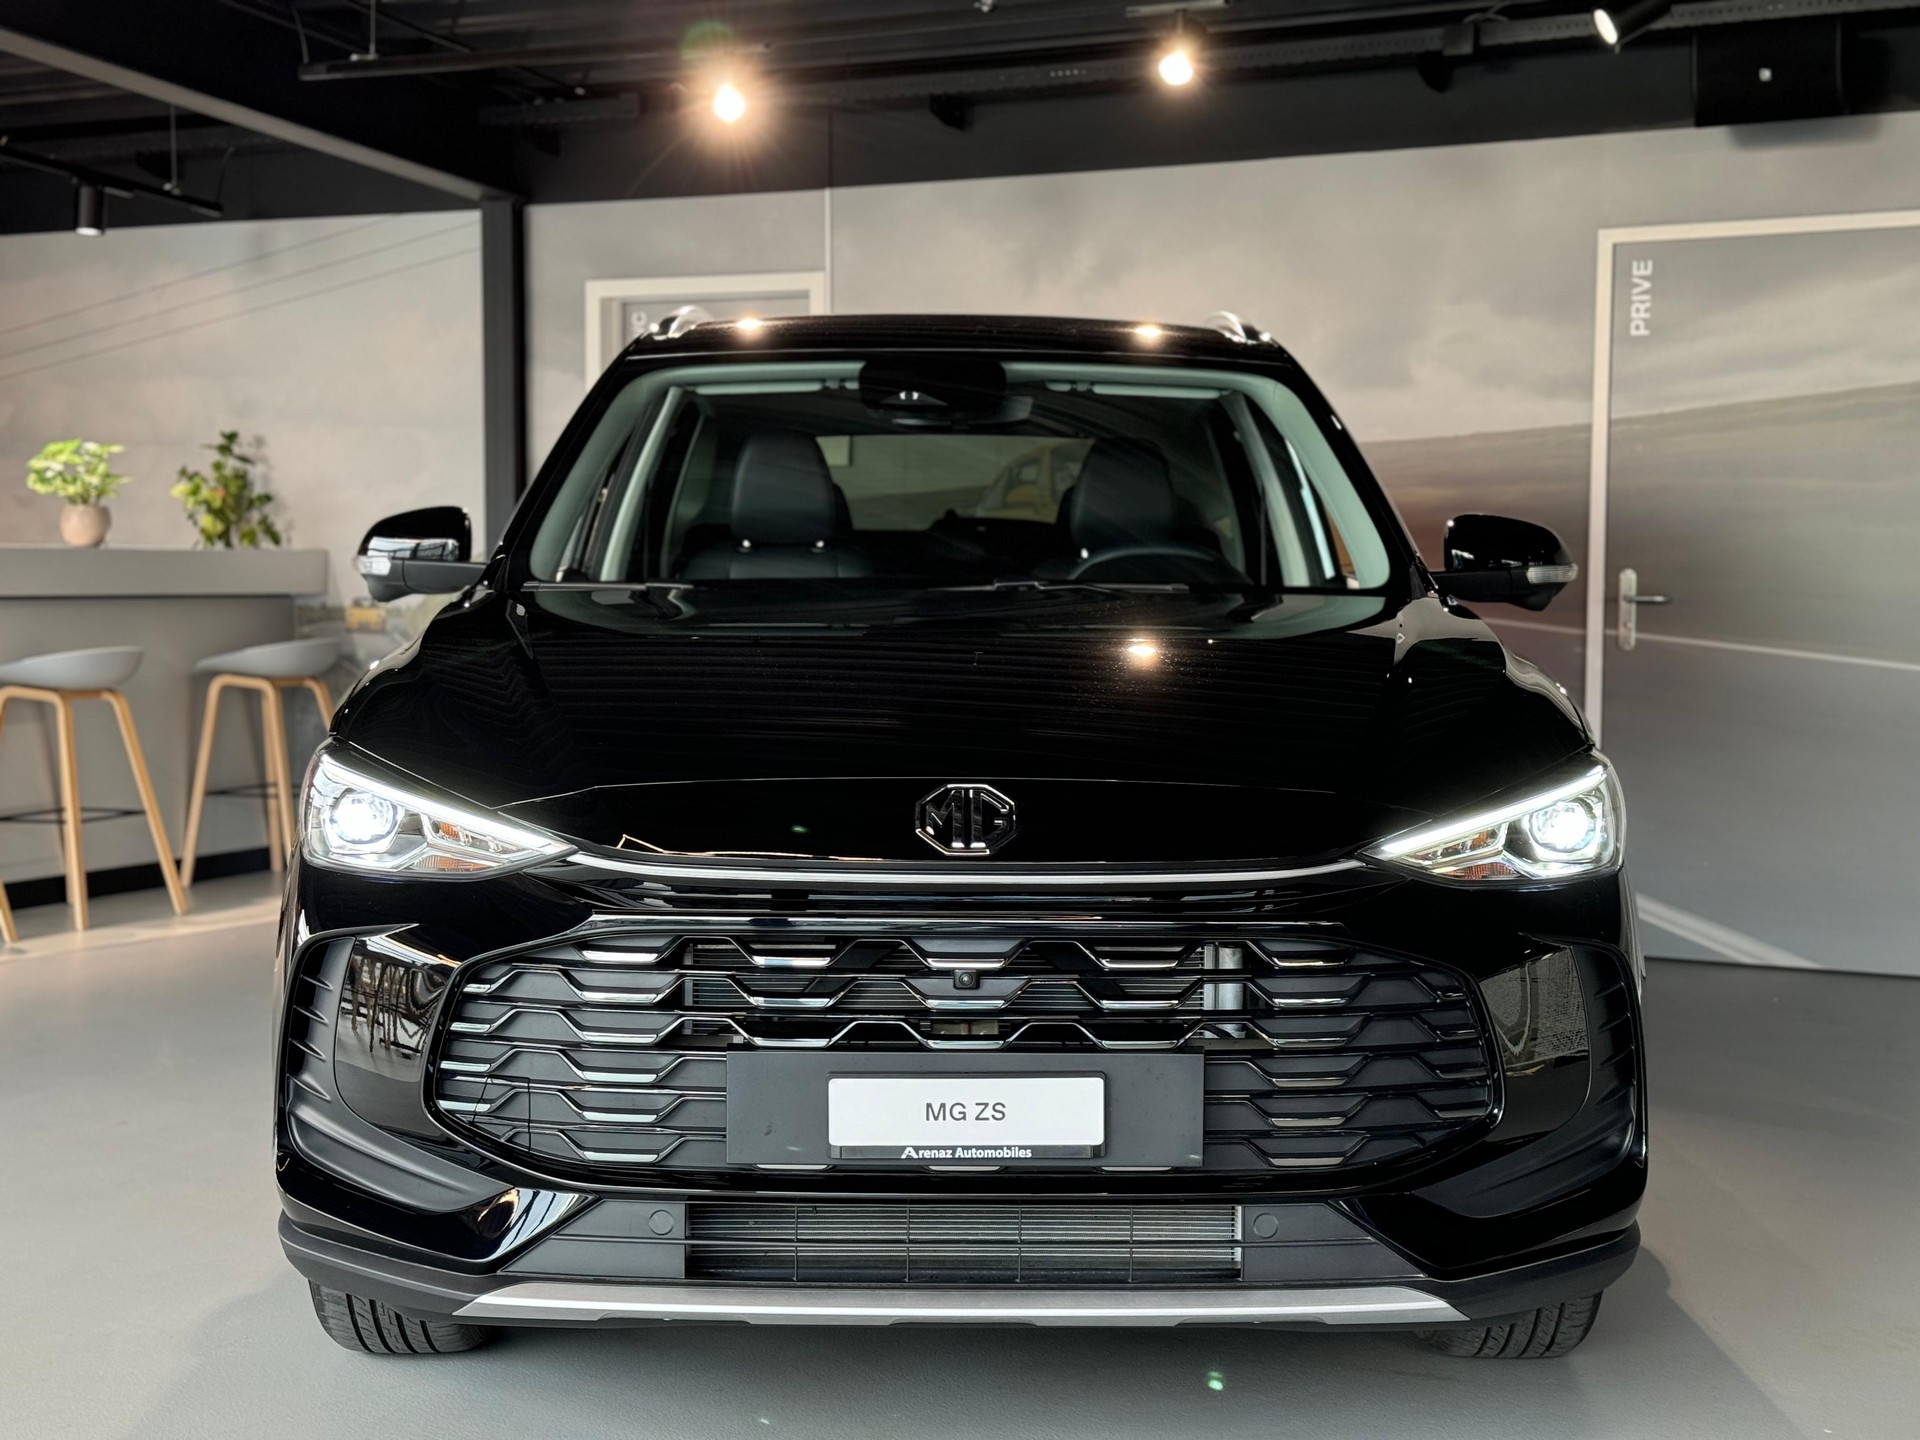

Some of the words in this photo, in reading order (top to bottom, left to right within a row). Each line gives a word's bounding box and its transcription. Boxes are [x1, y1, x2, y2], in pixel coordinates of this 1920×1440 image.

[1630, 260, 1653, 336] PRIVE
[924, 787, 1011, 849] MG
[925, 1102, 967, 1121] MG
[974, 1102, 1007, 1121] ZS
[900, 1146, 953, 1159] Arenaz
[955, 1146, 1032, 1158] Automobiles
